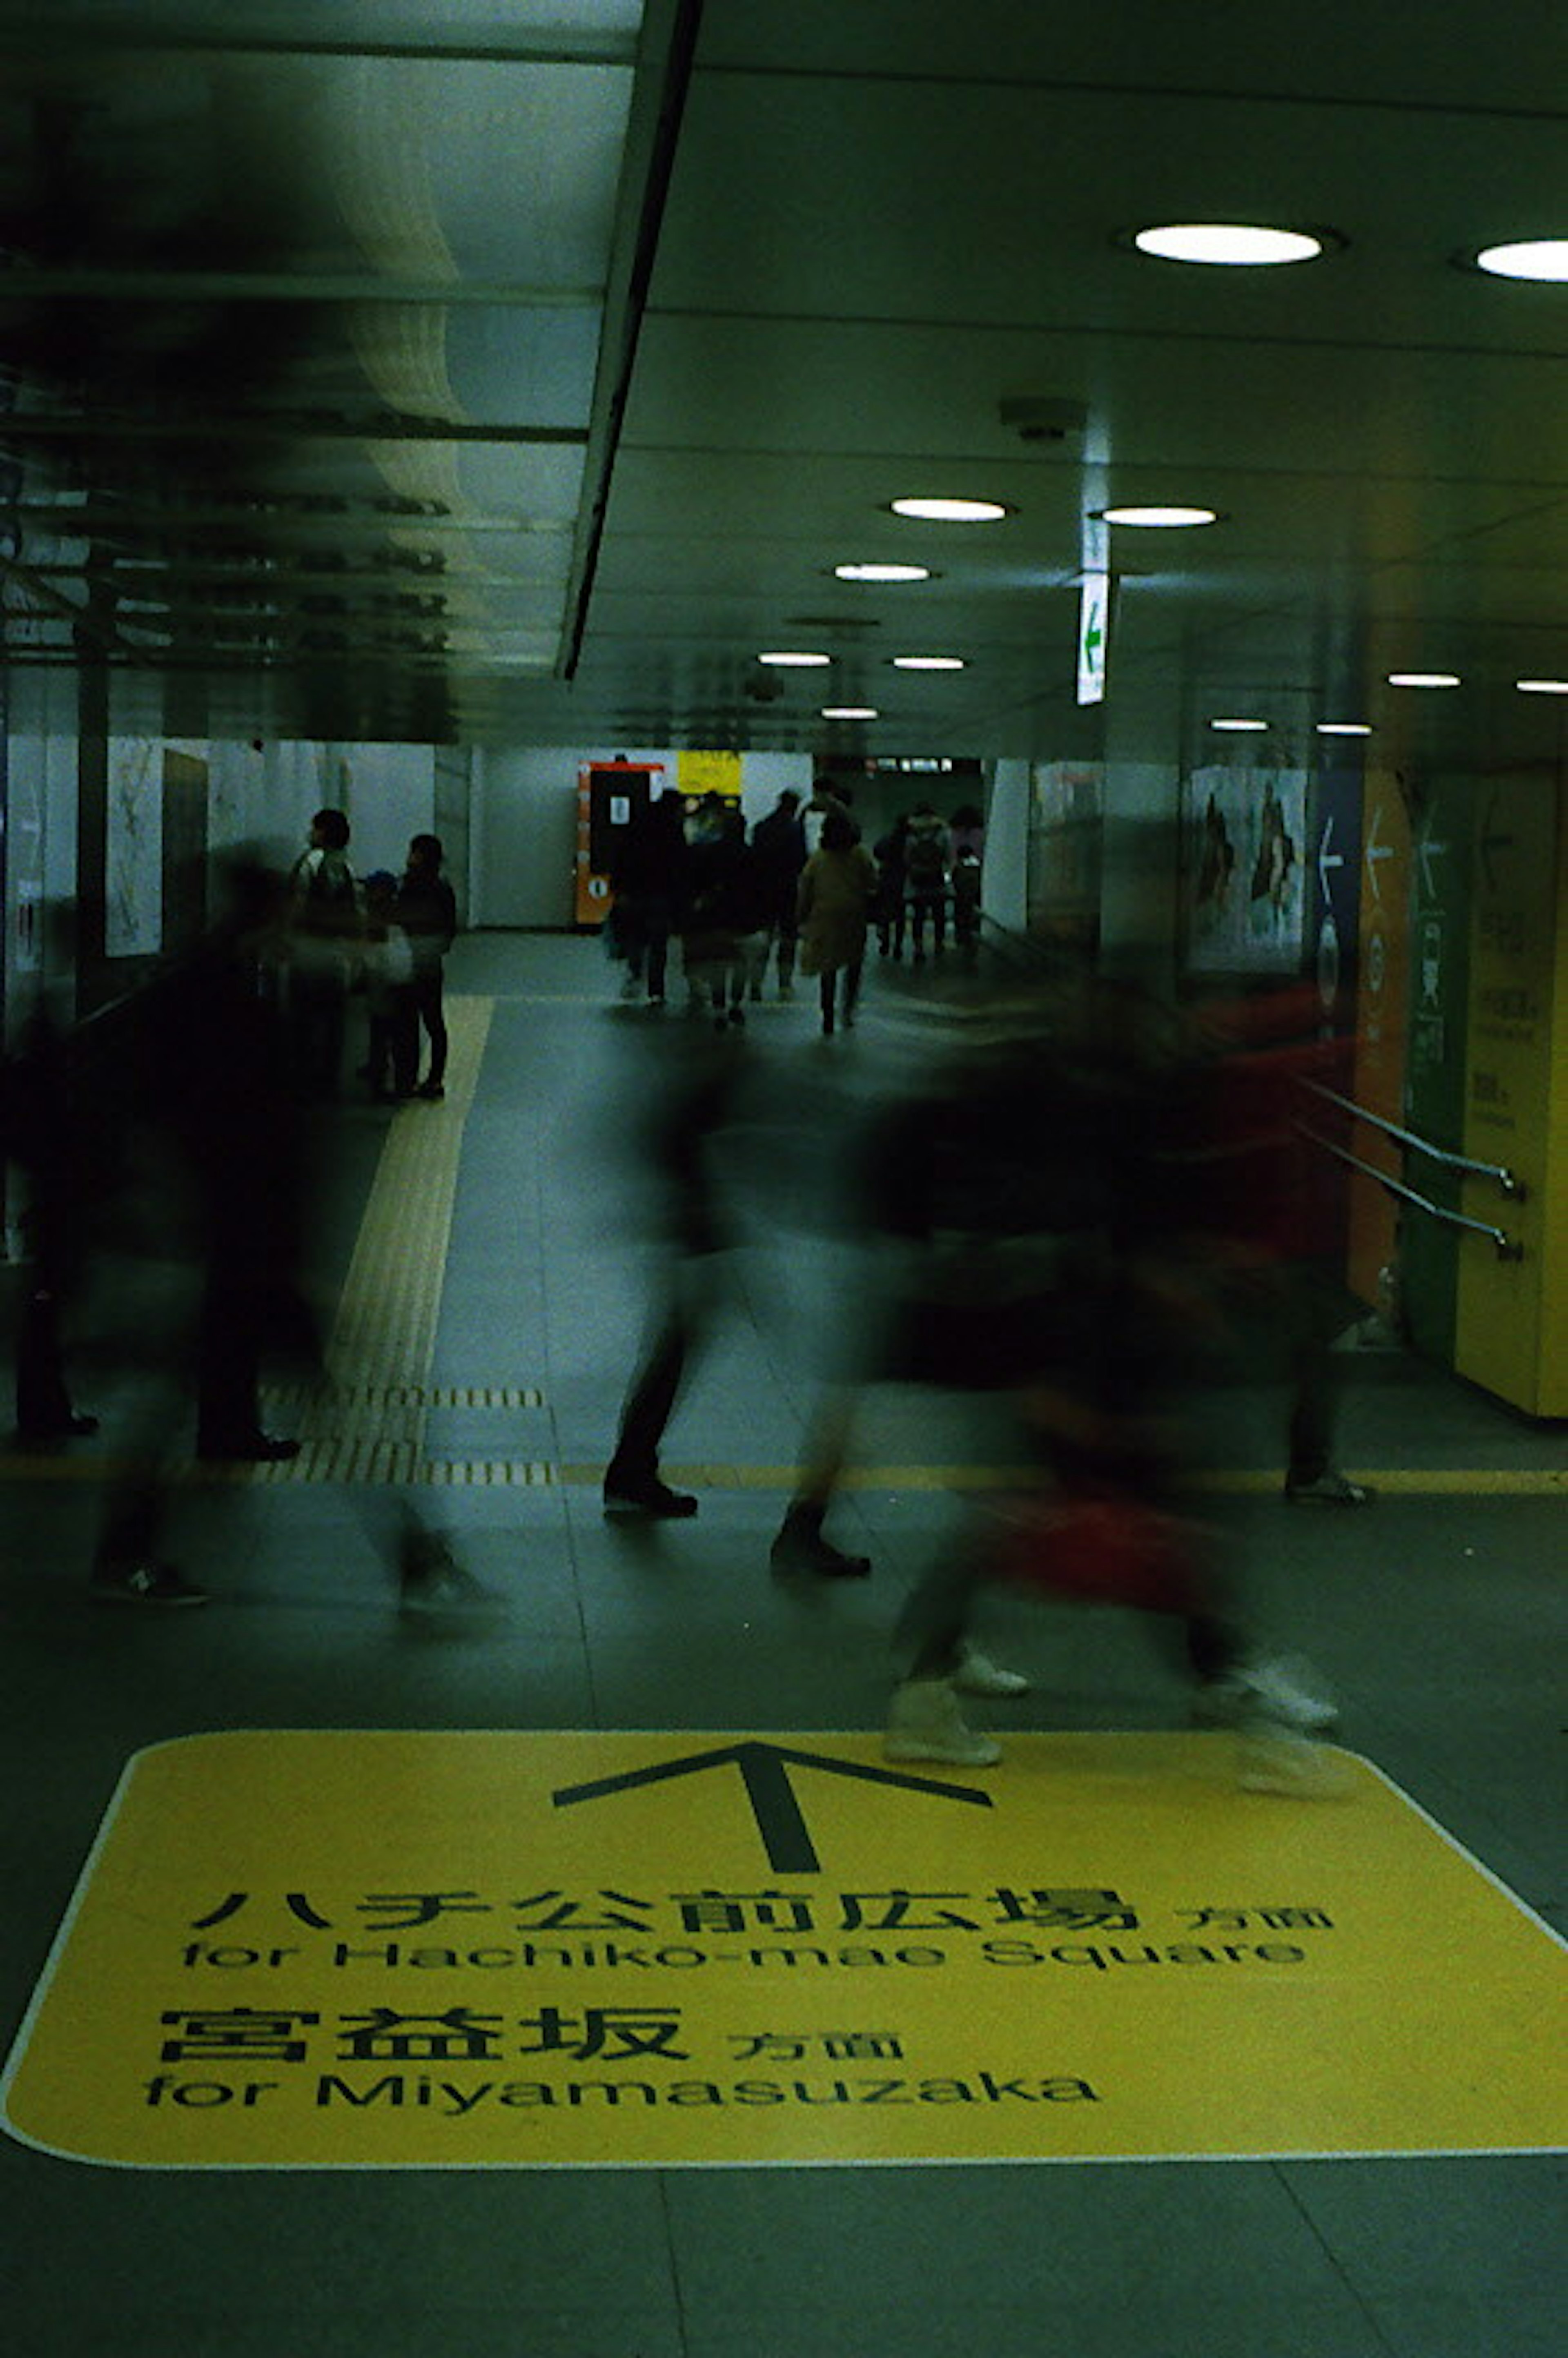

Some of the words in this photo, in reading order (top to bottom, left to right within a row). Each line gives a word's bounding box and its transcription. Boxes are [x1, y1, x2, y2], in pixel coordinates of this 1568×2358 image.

[191, 1891, 1139, 1932] ハチ公前広場
[1174, 1906, 1334, 1930] 方面
[183, 1943, 300, 1968] for
[334, 1943, 945, 1968] Hachiko-mae
[982, 1942, 1304, 1970] Square
[160, 2007, 690, 2063] 宮益坂
[728, 2031, 904, 2061] 方面
[144, 2075, 278, 2107] for
[316, 2071, 1100, 2116] Miyamasuzaka
